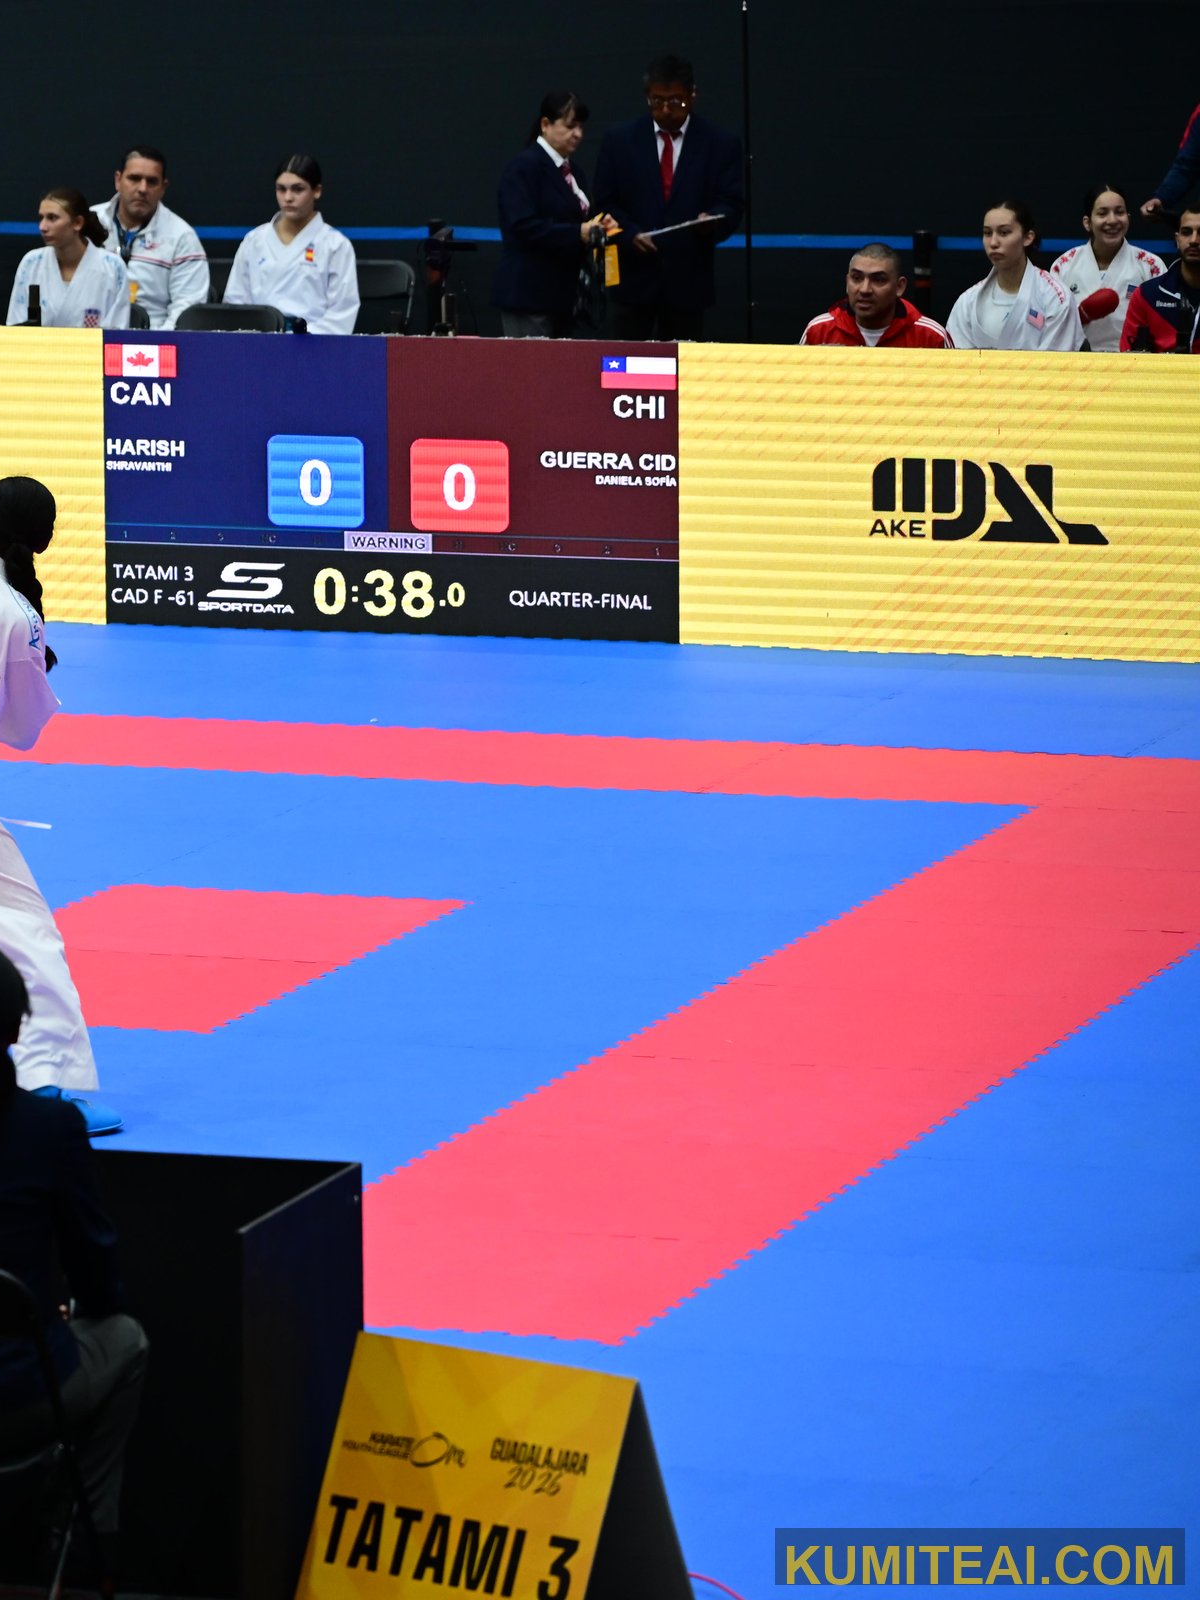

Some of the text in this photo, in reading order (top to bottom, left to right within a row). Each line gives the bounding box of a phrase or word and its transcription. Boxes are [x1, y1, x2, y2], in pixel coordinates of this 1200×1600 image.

[110, 381, 172, 407] CAN
[612, 394, 665, 420] CHI
[106, 438, 185, 458] HARISH
[106, 460, 173, 472] SHRAVANTHI
[540, 450, 677, 472] GUERRA CID
[299, 459, 332, 506] 0
[443, 463, 476, 511] 0
[595, 474, 677, 488] DANIELA SOFÍA
[869, 518, 926, 538] AKE
[351, 535, 427, 551] WARNING
[112, 563, 195, 582] TATAMI 3
[111, 587, 195, 606] CAD F -61
[508, 590, 652, 611] QUARTER-FINAL
[197, 601, 295, 615] SPORTDATA
[369, 1431, 415, 1449] KARATE
[489, 1436, 590, 1477] GUADALAJARA
[324, 1494, 581, 1600] TATAMI 3
